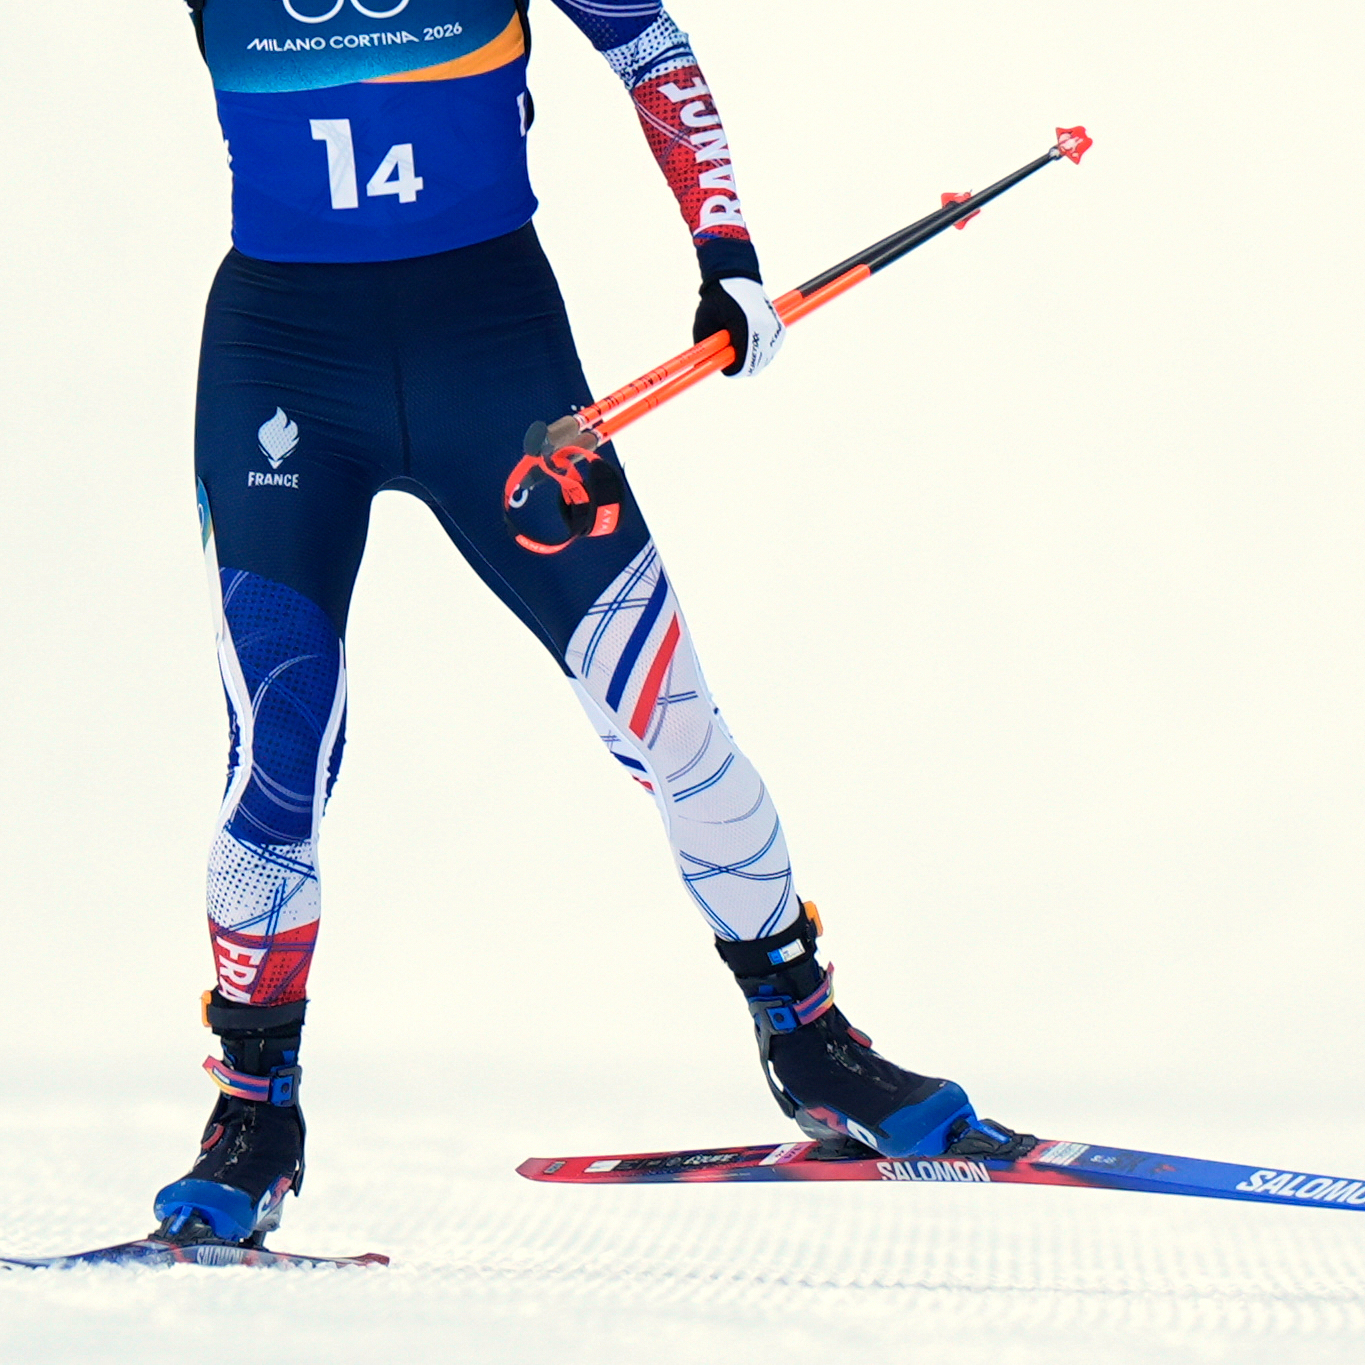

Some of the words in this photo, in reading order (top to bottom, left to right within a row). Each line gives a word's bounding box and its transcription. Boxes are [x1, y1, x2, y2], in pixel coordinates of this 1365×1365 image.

[246, 36, 326, 52] MILANO
[329, 30, 420, 49] CORTINA
[423, 22, 463, 41] 2026
[247, 471, 300, 489] FRANCE
[876, 1160, 991, 1182] SALOMON
